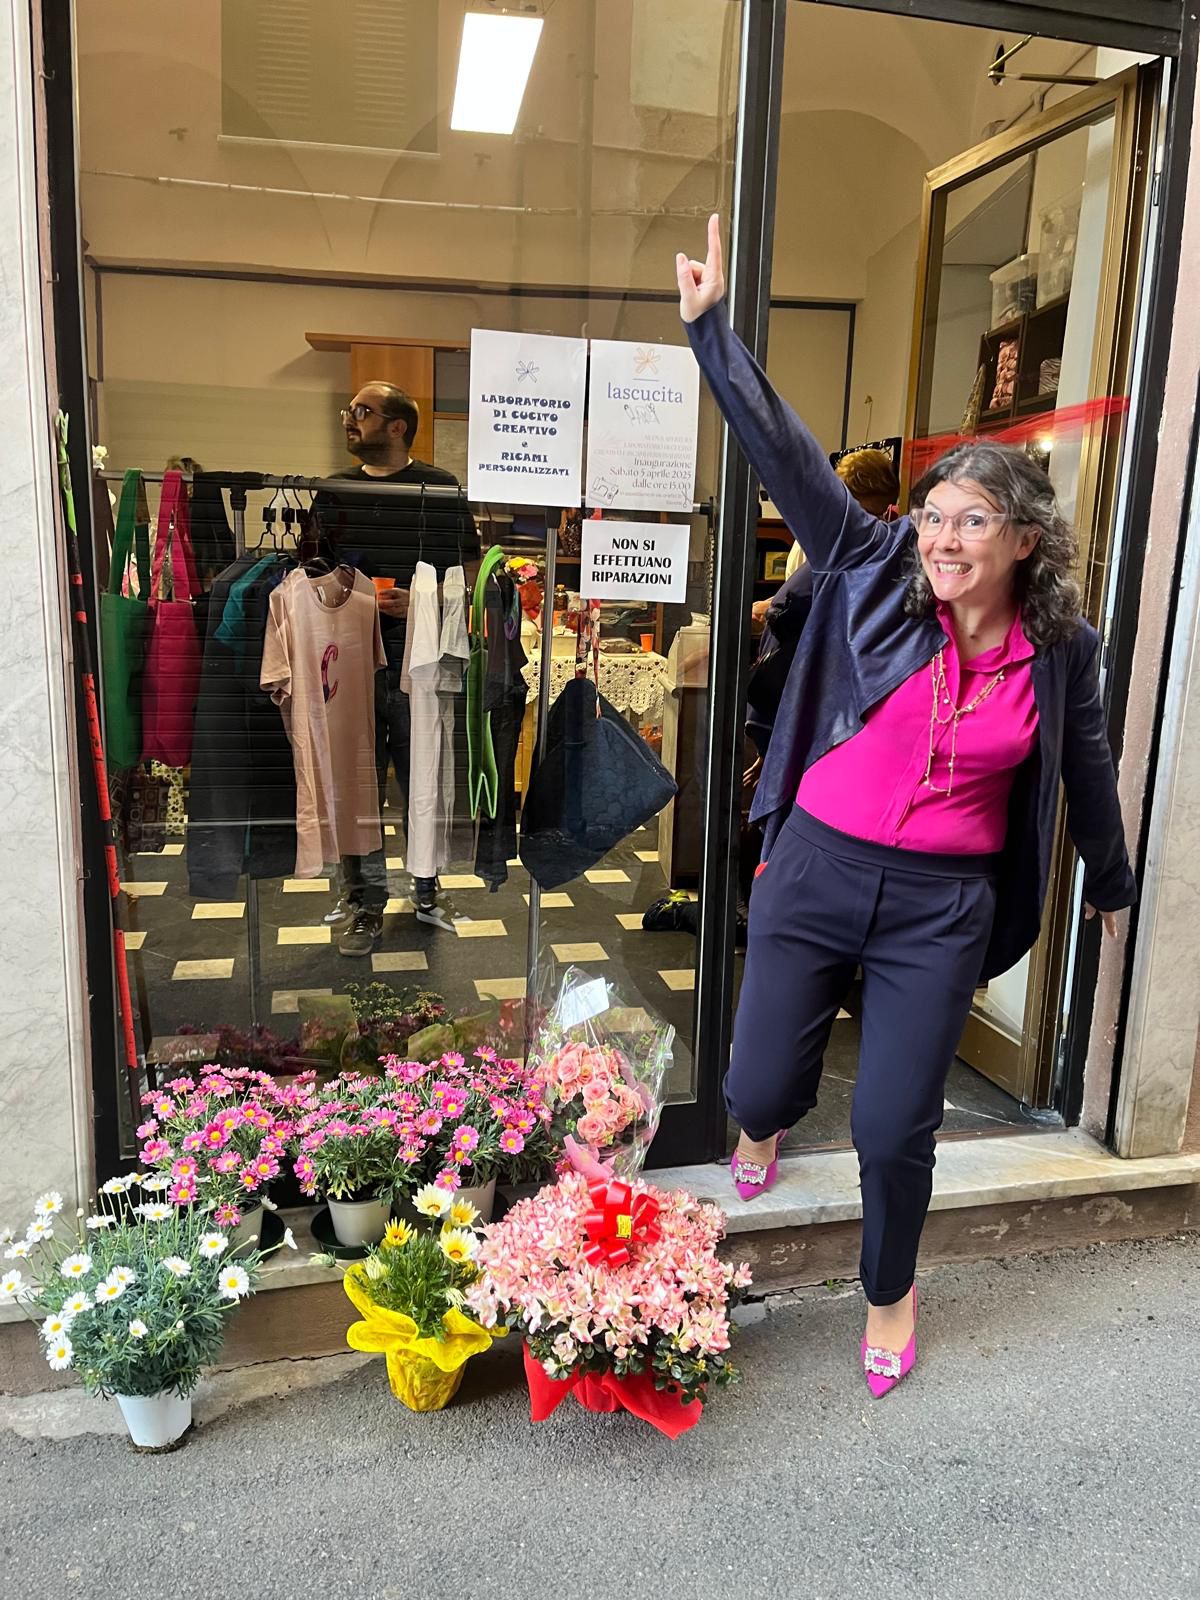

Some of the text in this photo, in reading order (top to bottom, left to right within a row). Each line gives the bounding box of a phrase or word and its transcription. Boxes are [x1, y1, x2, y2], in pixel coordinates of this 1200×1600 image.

[608, 382, 683, 403] lascucita
[481, 394, 571, 409] LABORATORIO
[494, 409, 558, 422] DI CUCITO
[493, 423, 557, 436] CREATIVO
[501, 451, 548, 463] RICAMI
[634, 457, 692, 469] Inaugurazione
[478, 463, 569, 476] PERSONALIZZATI
[610, 466, 692, 479] Sabato 5 aprile 2025
[632, 478, 651, 488] dalle
[612, 538, 655, 551] NON SI
[593, 554, 672, 569] EFFETTUANO
[591, 571, 672, 585] RIPARAZIONI
